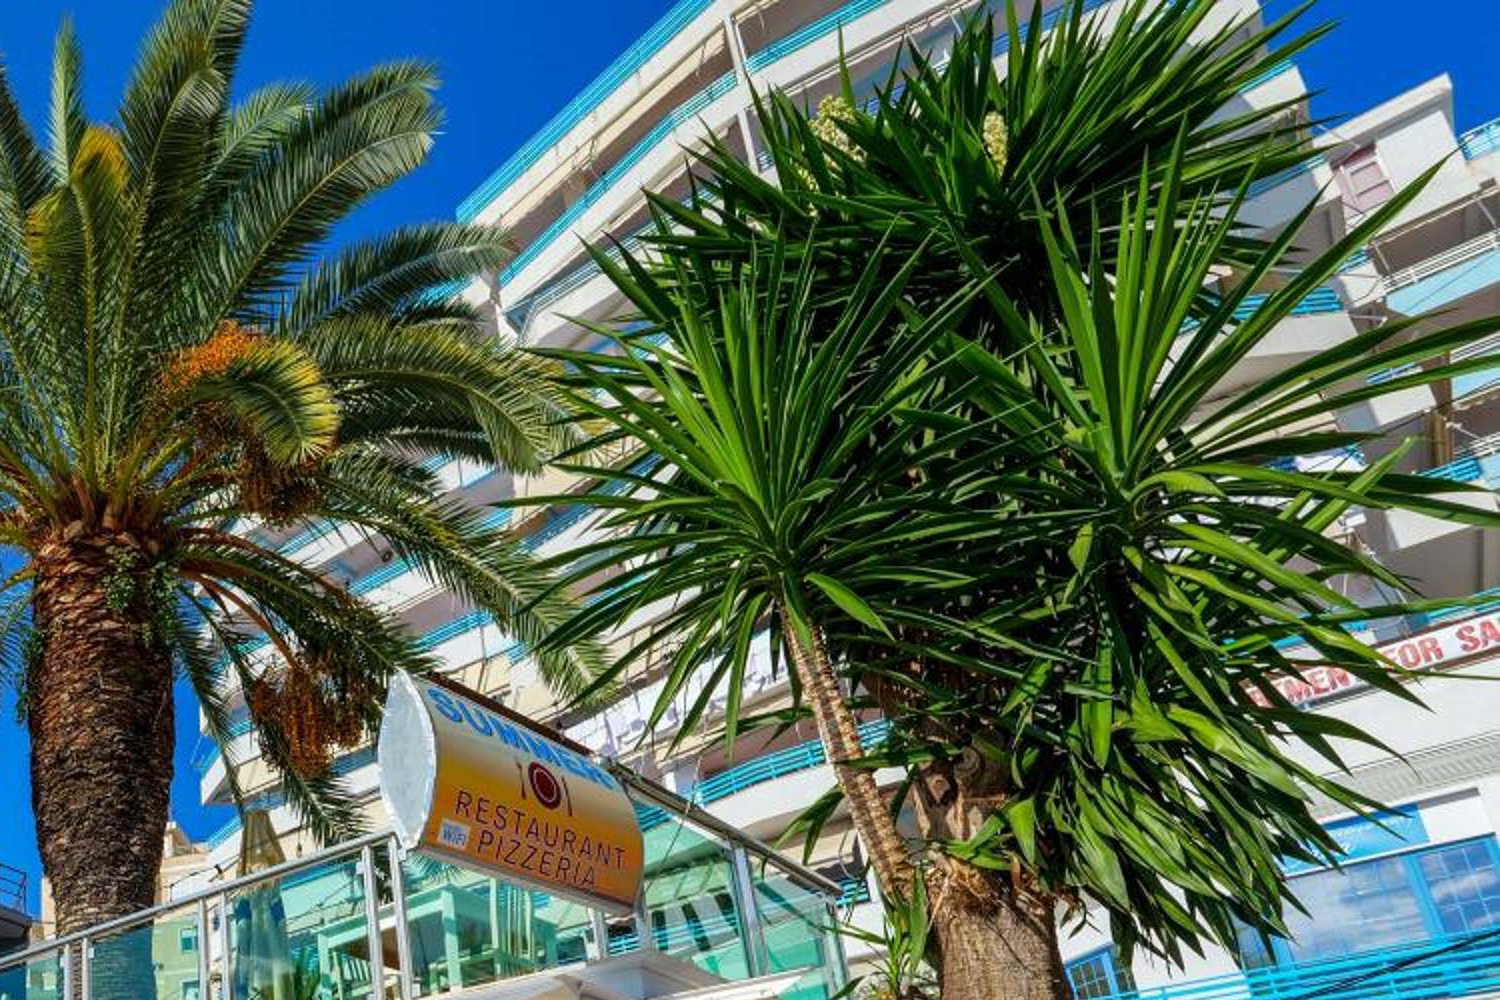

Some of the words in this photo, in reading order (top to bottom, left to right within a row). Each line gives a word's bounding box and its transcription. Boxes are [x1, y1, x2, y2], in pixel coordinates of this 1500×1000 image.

[426, 687, 615, 791] SUMMER
[454, 788, 626, 870] RESTAURANT
[476, 829, 596, 887] PIZZERIA
